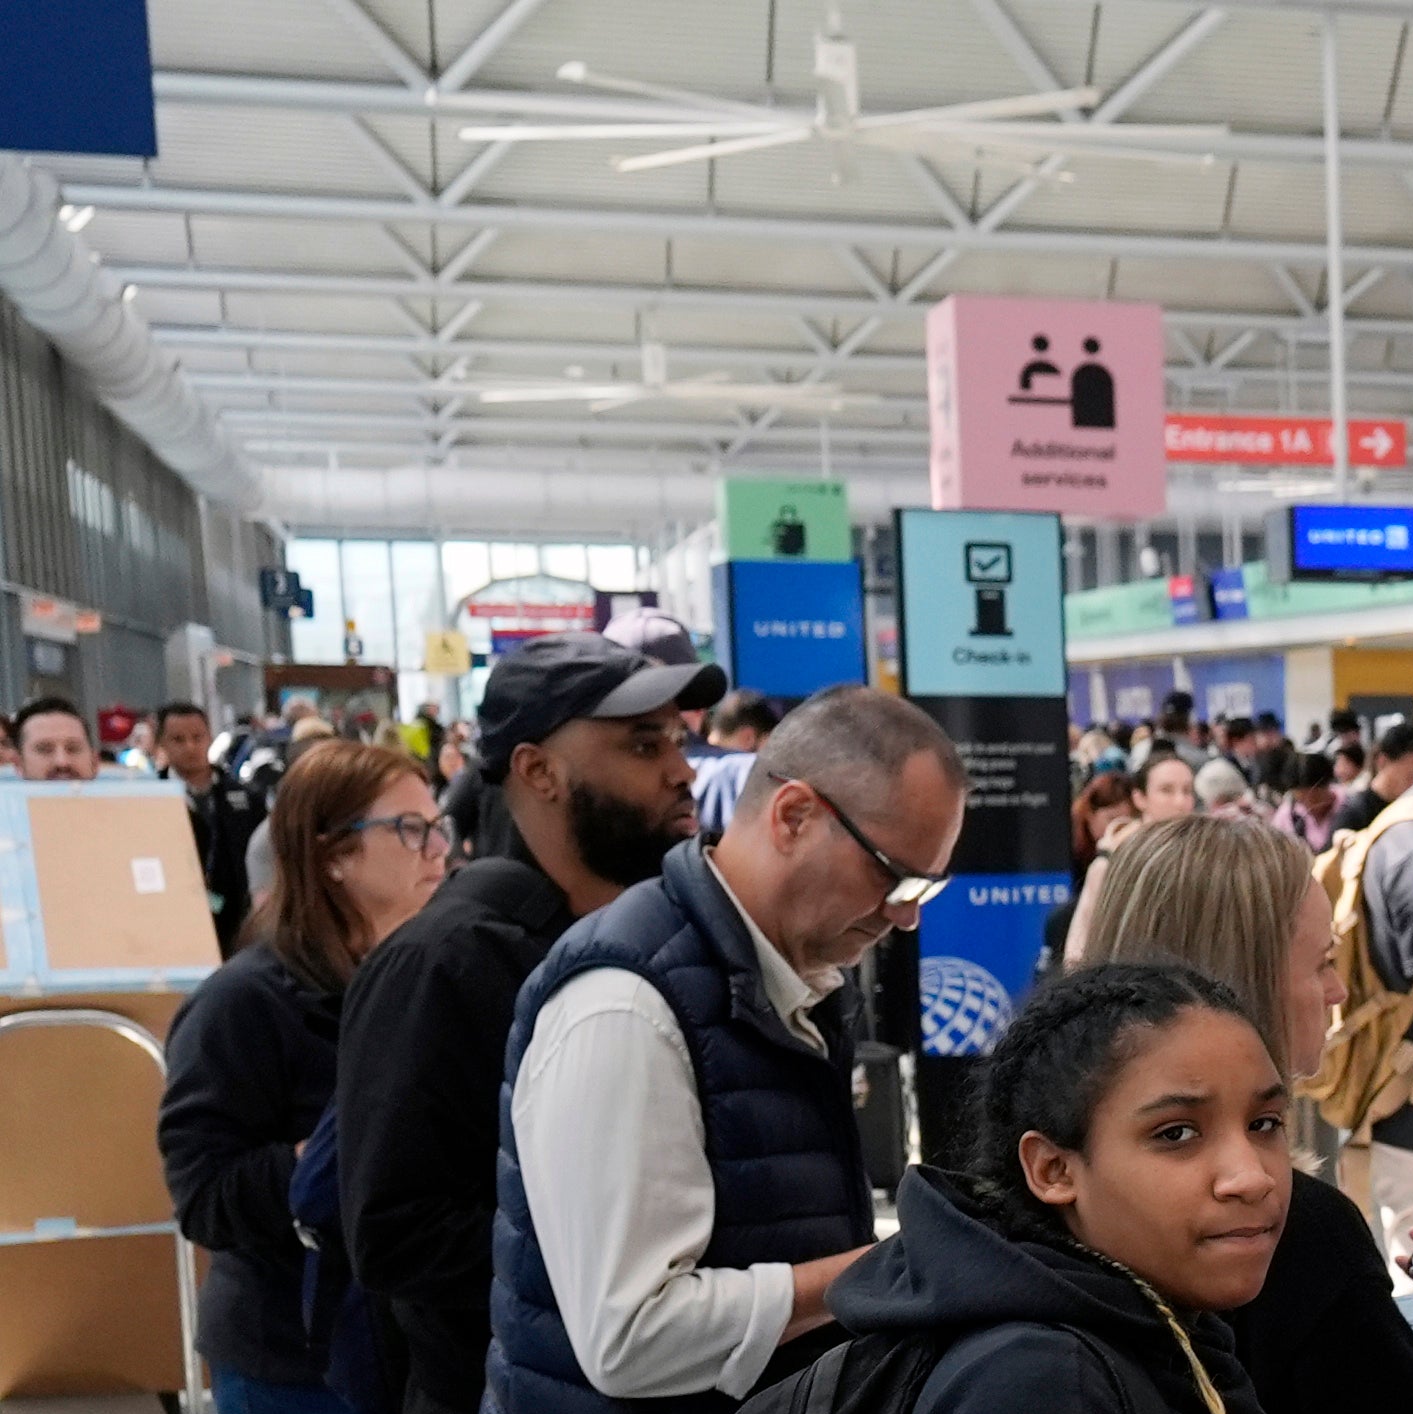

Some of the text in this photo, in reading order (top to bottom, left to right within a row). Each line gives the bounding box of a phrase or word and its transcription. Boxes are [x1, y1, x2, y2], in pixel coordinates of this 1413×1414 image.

[1165, 424, 1312, 454] Entrance 1A
[1011, 440, 1115, 460] Additional
[1022, 473, 1108, 489] services
[753, 621, 846, 639] UNITED
[968, 884, 1070, 906] UNITED
